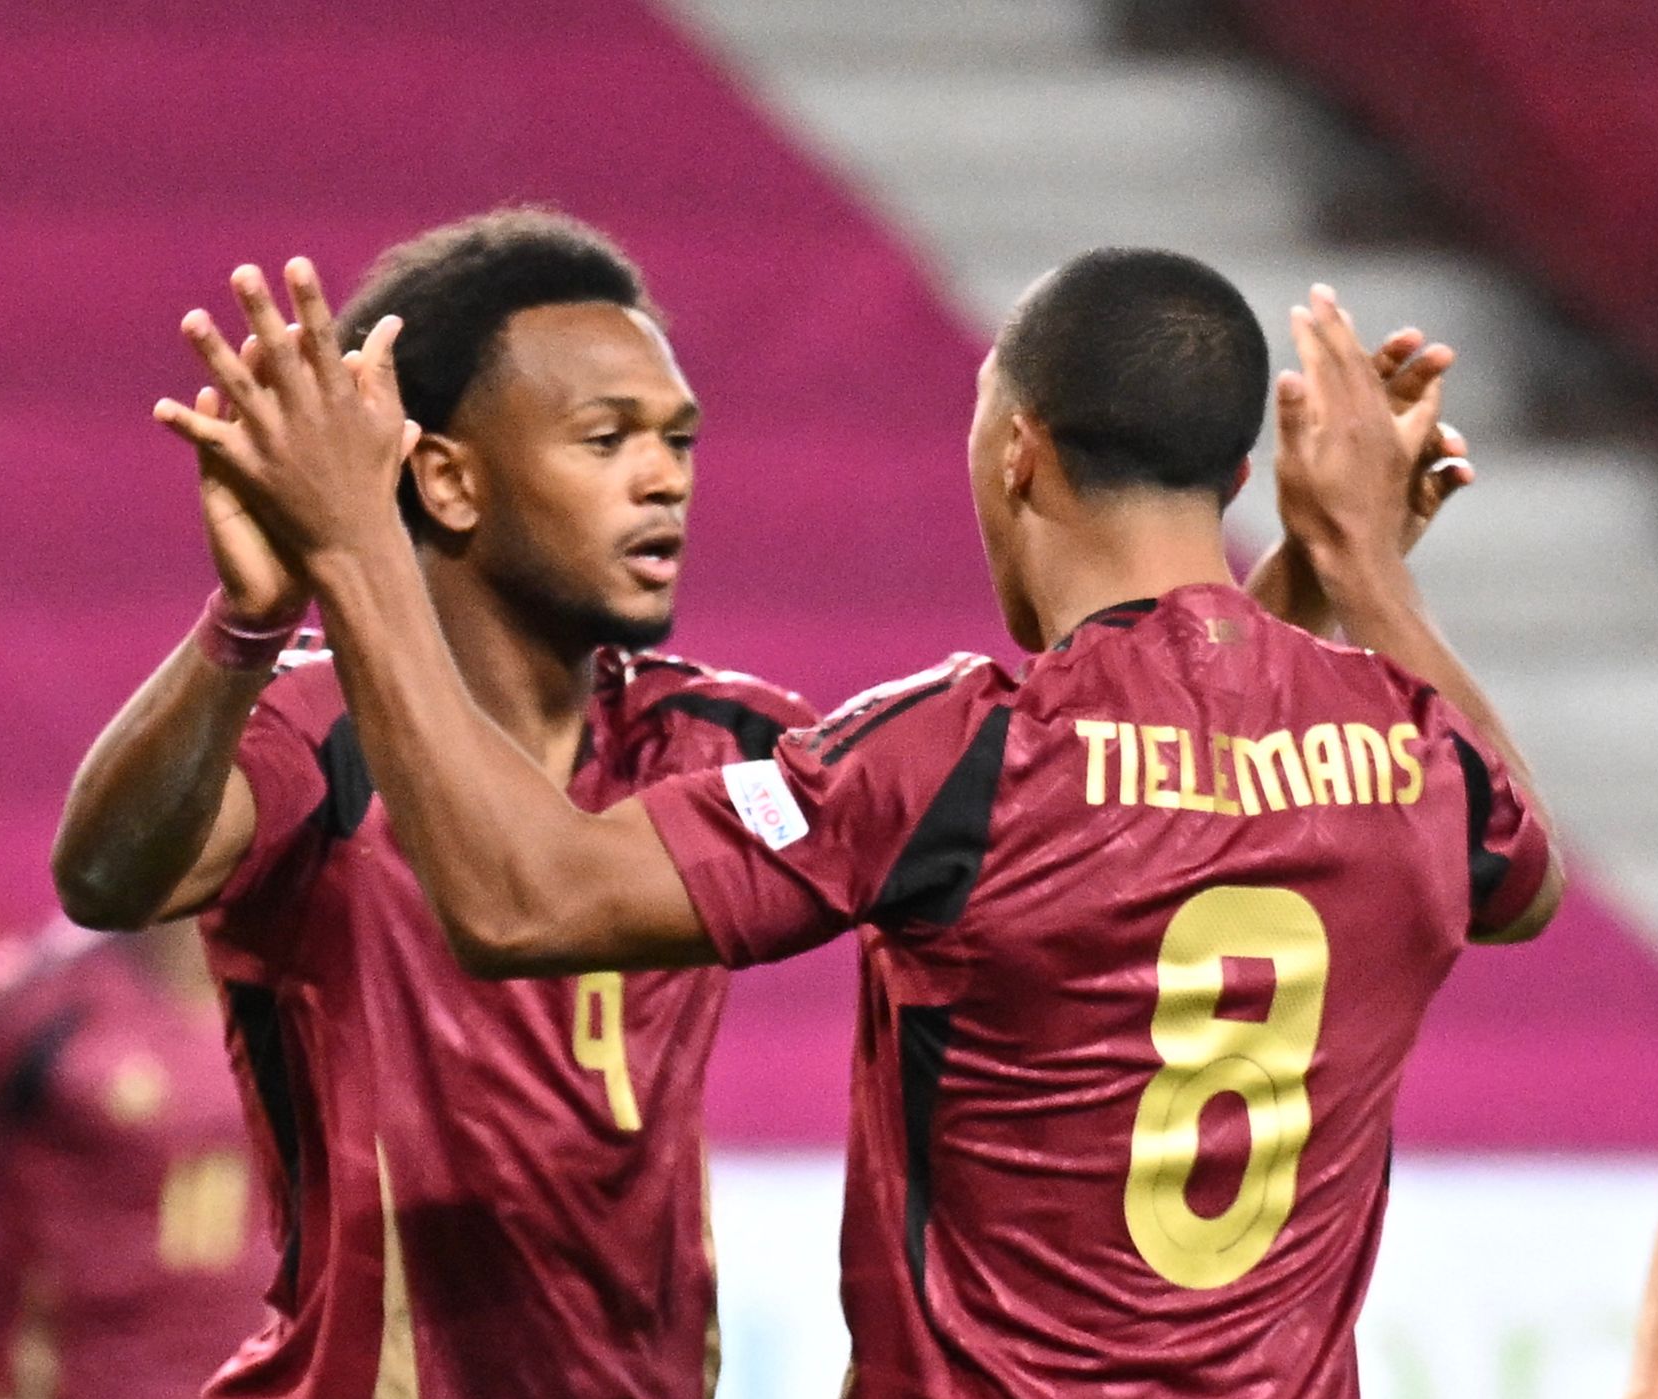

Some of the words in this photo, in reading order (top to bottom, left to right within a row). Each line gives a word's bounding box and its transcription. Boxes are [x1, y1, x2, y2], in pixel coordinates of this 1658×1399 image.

[1075, 719, 1425, 816] TIELEMANS
[572, 971, 642, 1131] 9
[1124, 886, 1330, 1290] 8
